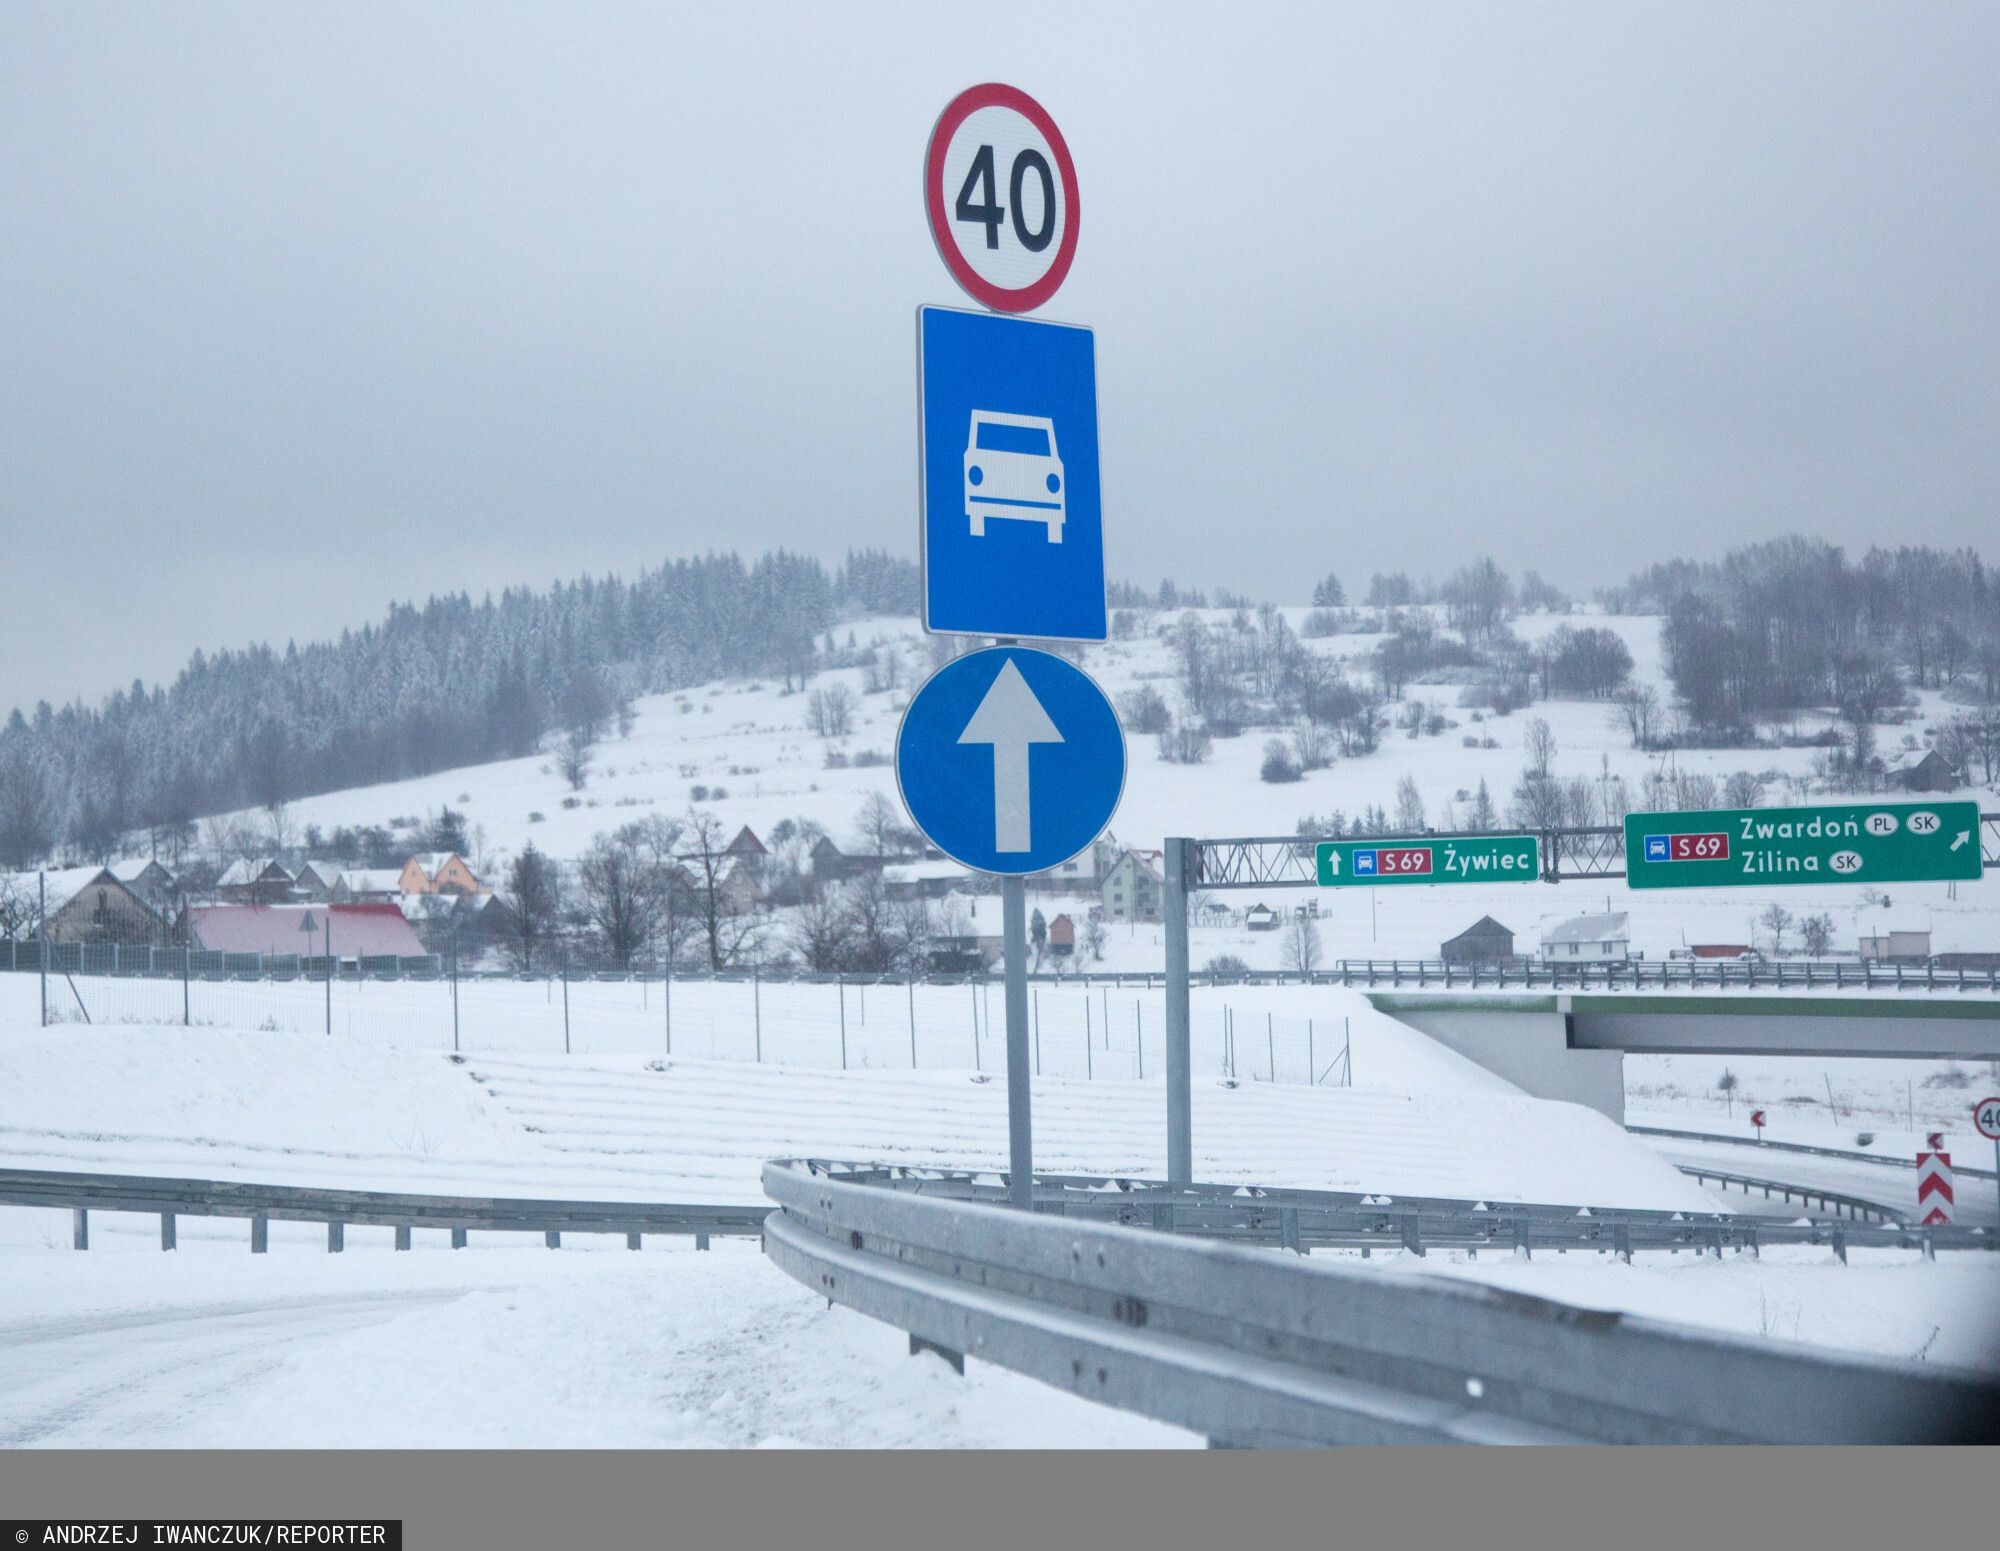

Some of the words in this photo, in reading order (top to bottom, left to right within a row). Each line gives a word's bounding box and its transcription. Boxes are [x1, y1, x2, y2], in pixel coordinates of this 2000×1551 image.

[955, 144, 1056, 253] 40
[1740, 814, 1859, 840] Zwardoń
[1873, 817, 1892, 832] PL
[1913, 815, 1935, 831] SK
[1678, 838, 1691, 857] S
[1695, 837, 1721, 856] 69
[1385, 853, 1396, 871] S
[1400, 852, 1424, 870] 69
[1444, 843, 1529, 877] Żywiec
[1742, 850, 1819, 873] Zilina
[1836, 854, 1857, 870] SK
